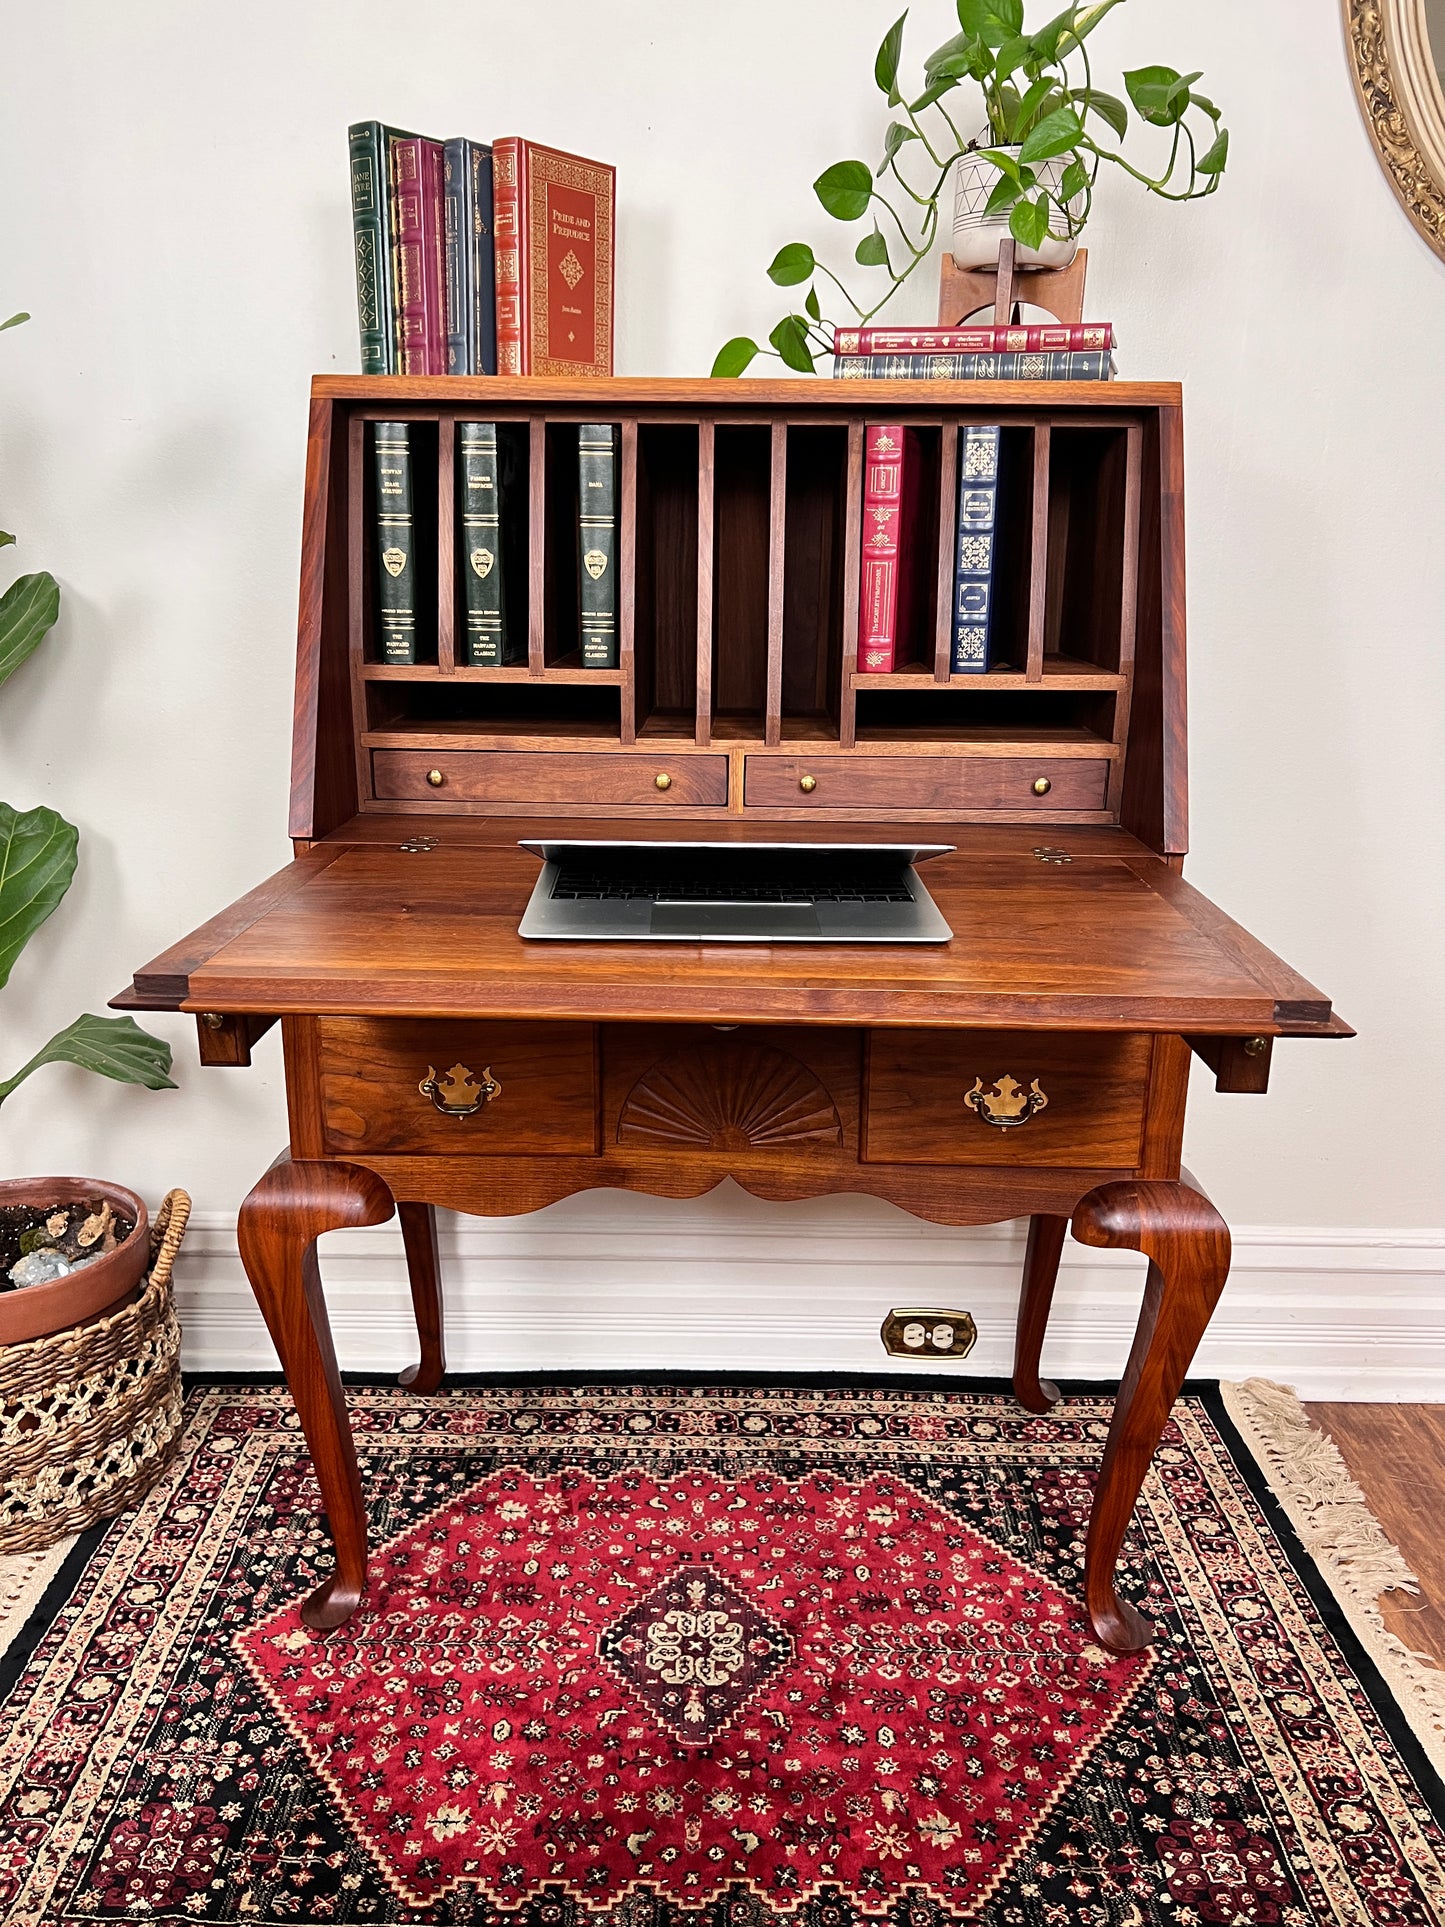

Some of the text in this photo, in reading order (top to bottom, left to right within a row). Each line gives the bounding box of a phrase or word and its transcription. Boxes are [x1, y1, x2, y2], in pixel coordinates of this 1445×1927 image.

[552, 209, 590, 228] PRIDE AND
[552, 222, 590, 242] PREJUDICE
